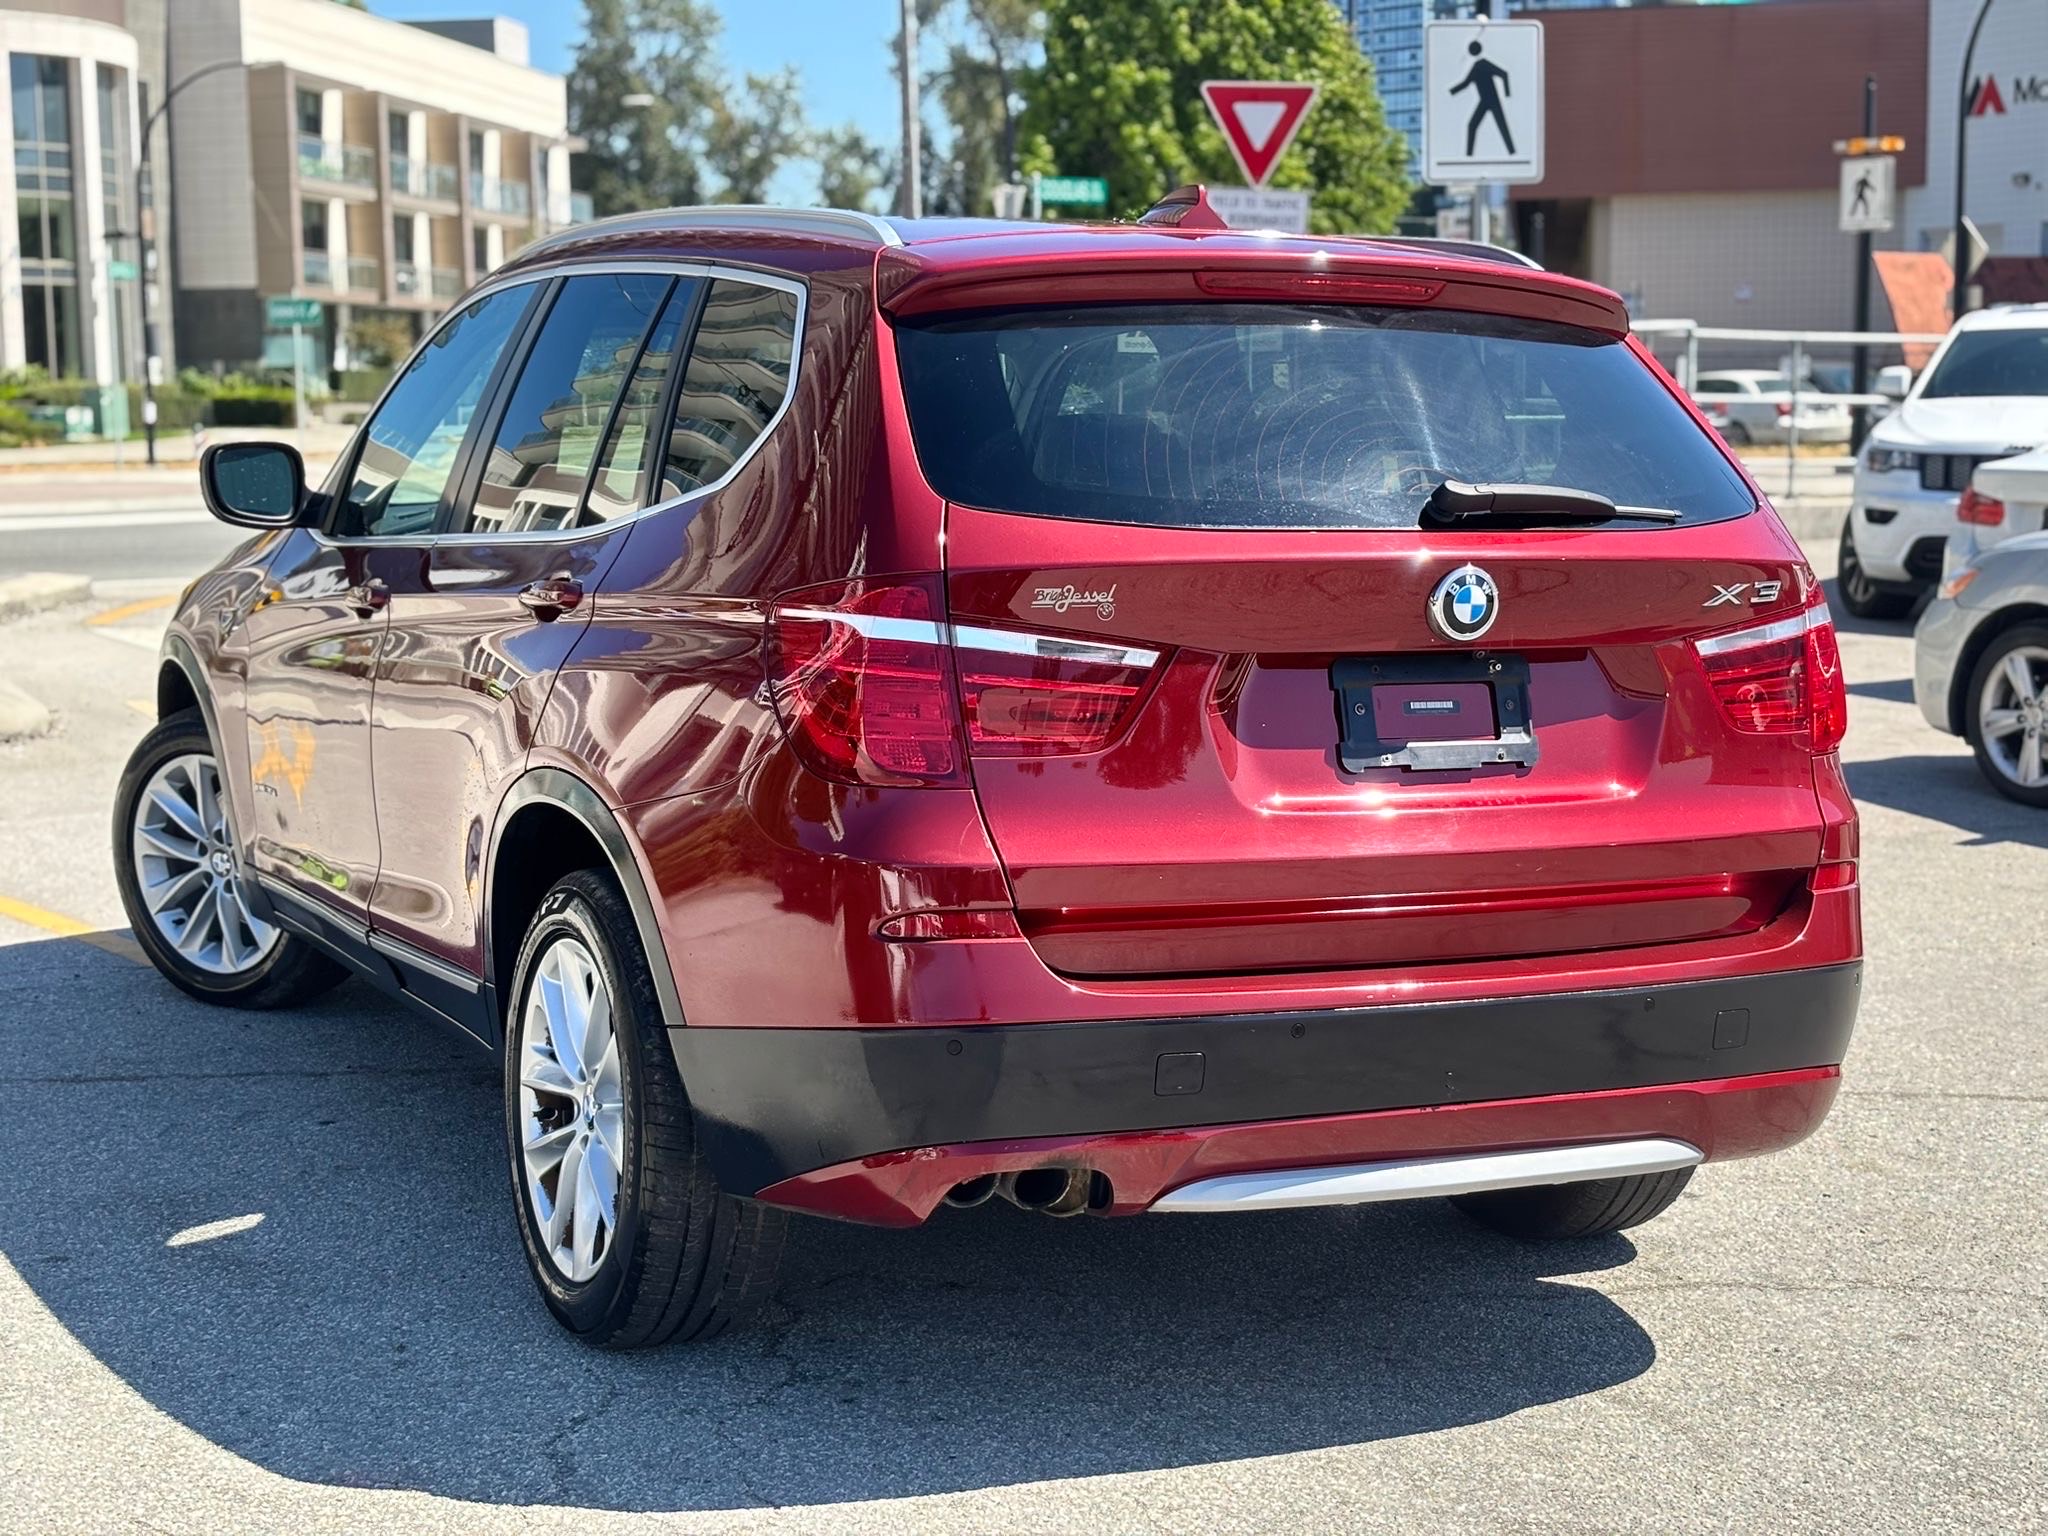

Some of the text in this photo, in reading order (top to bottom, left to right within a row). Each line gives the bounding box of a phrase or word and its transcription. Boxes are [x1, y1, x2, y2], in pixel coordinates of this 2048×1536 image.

[1055, 584, 1117, 612] Jessel
[1447, 574, 1493, 597] BMW
[1702, 580, 1781, 607] X3
[541, 893, 567, 915] P7
